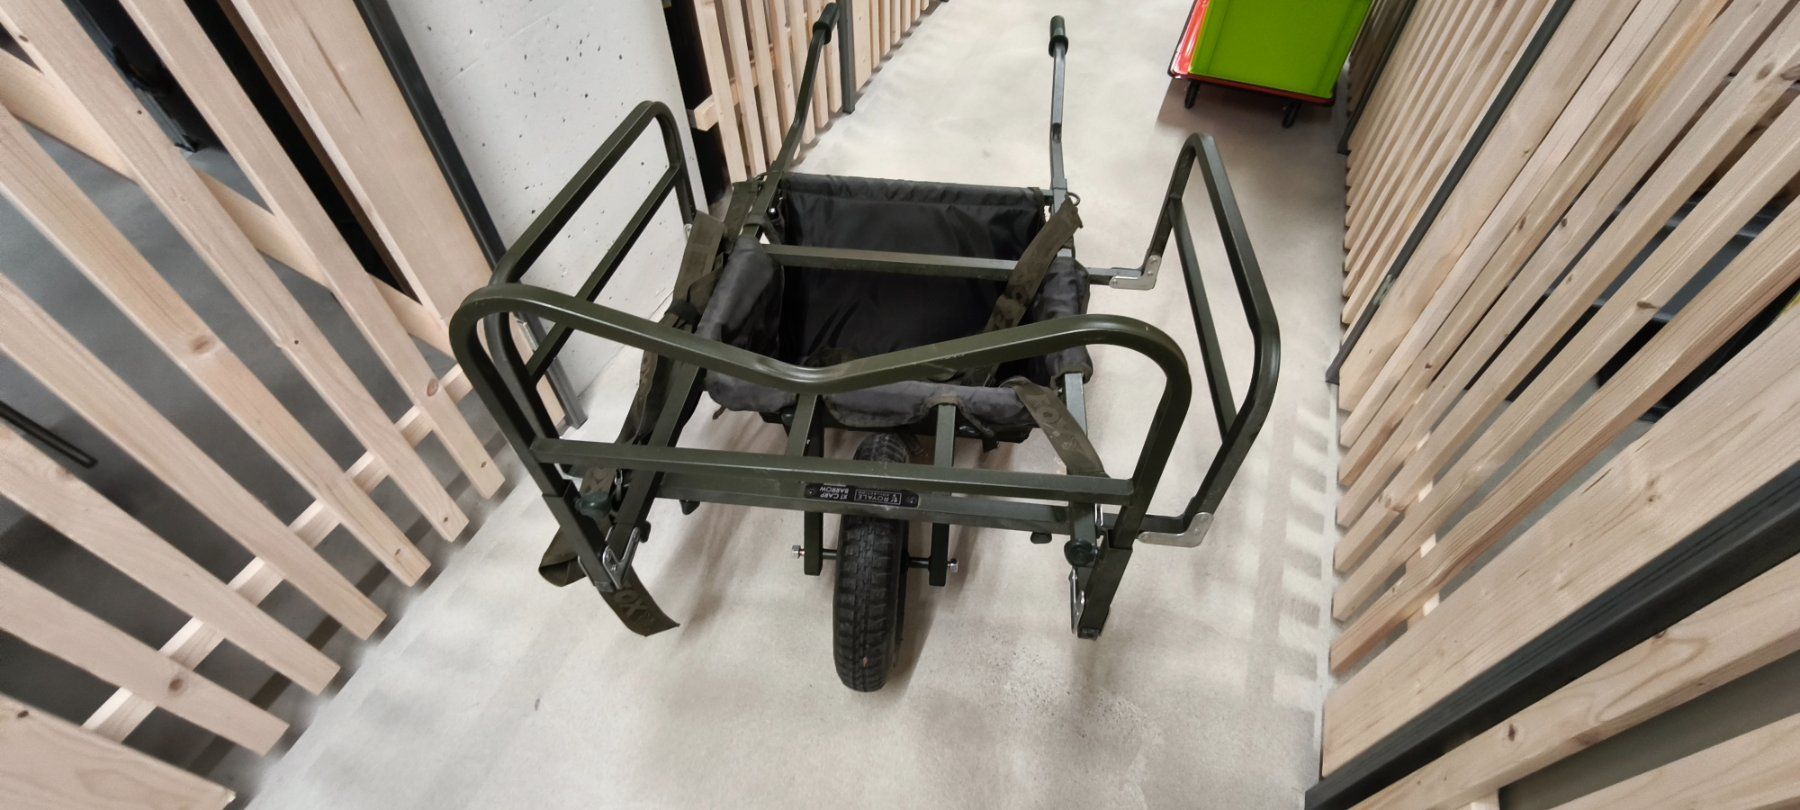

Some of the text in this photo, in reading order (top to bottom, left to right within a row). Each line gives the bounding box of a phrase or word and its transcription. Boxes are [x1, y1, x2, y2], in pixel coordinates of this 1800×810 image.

[819, 486, 850, 494] BARROW
[819, 492, 839, 500] CARP
[858, 494, 889, 503] ROYALE
